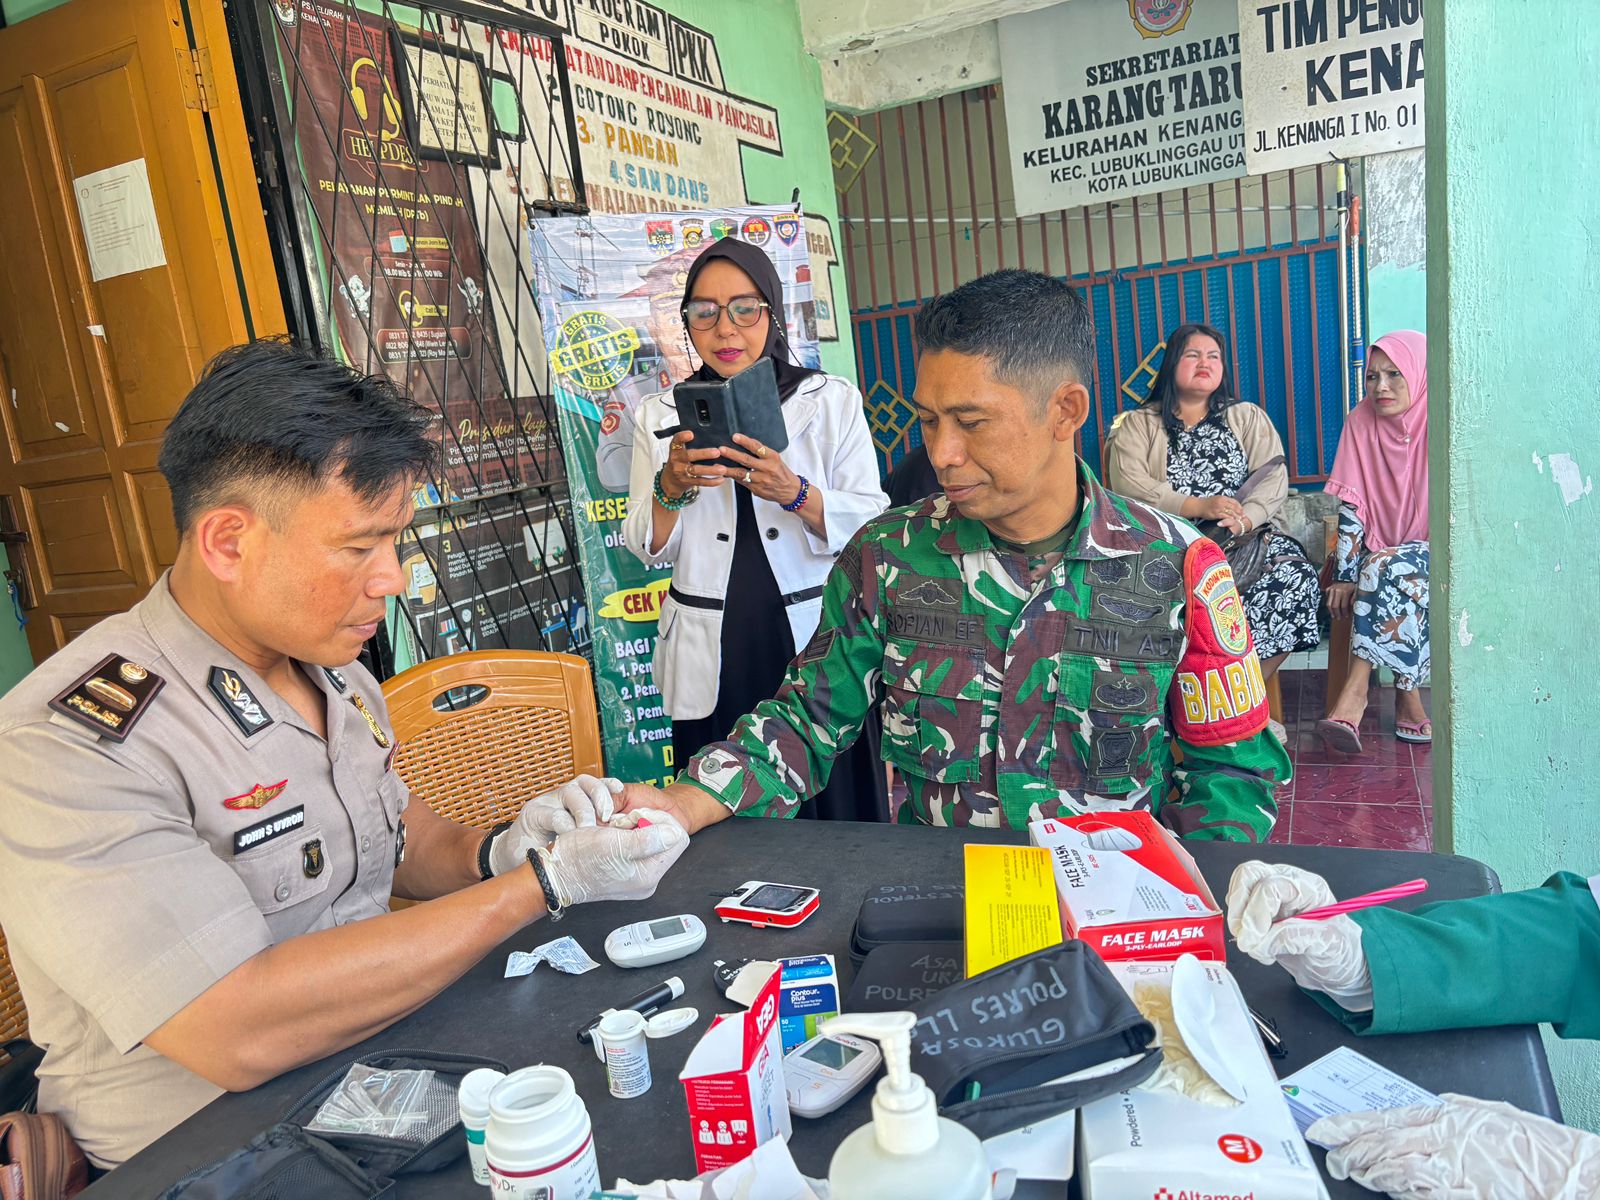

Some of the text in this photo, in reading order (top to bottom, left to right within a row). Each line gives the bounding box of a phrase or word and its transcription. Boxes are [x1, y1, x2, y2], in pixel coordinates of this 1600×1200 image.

[599, 21, 650, 62] POKOK
[1257, 0, 1328, 53] TIM
[674, 24, 714, 86] PKK
[1085, 33, 1240, 87] SEKRETARIAT
[574, 84, 637, 126] GOTONG
[645, 106, 702, 146] ROYONG
[716, 100, 776, 141] PANCASILA
[1042, 78, 1164, 139] KARANG
[1365, 110, 1391, 134] No.
[1397, 103, 1417, 127] 01
[603, 121, 679, 168] PANGAN
[1023, 128, 1148, 168] KELURAHAN
[1050, 164, 1087, 184] KEC.
[1091, 139, 1223, 176] LUBUKLINGGAU
[1088, 174, 1128, 194] KOTA
[564, 313, 607, 336] GRATIS
[558, 332, 633, 368] GRATIS
[584, 364, 626, 386] GRATIS
[442, 539, 451, 553] 3
[476, 603, 487, 617] 4
[623, 591, 655, 615] CEK
[614, 637, 650, 658] BAGI
[1073, 625, 1120, 652] TNI
[620, 686, 633, 700] 2.
[624, 709, 635, 724] 3.
[627, 731, 639, 745] 4.
[265, 824, 273, 836] S
[1054, 845, 1085, 889] FACE MASK
[1101, 926, 1205, 947] FACE MASK
[1124, 940, 1183, 951] 3-PLY-EARLOOP
[791, 996, 806, 1005] plus
[971, 966, 1068, 1024] POLRES
[756, 993, 775, 1036] GEA
[920, 1017, 1066, 1056] GLUKOSA
[1126, 1103, 1142, 1148] Powdered
